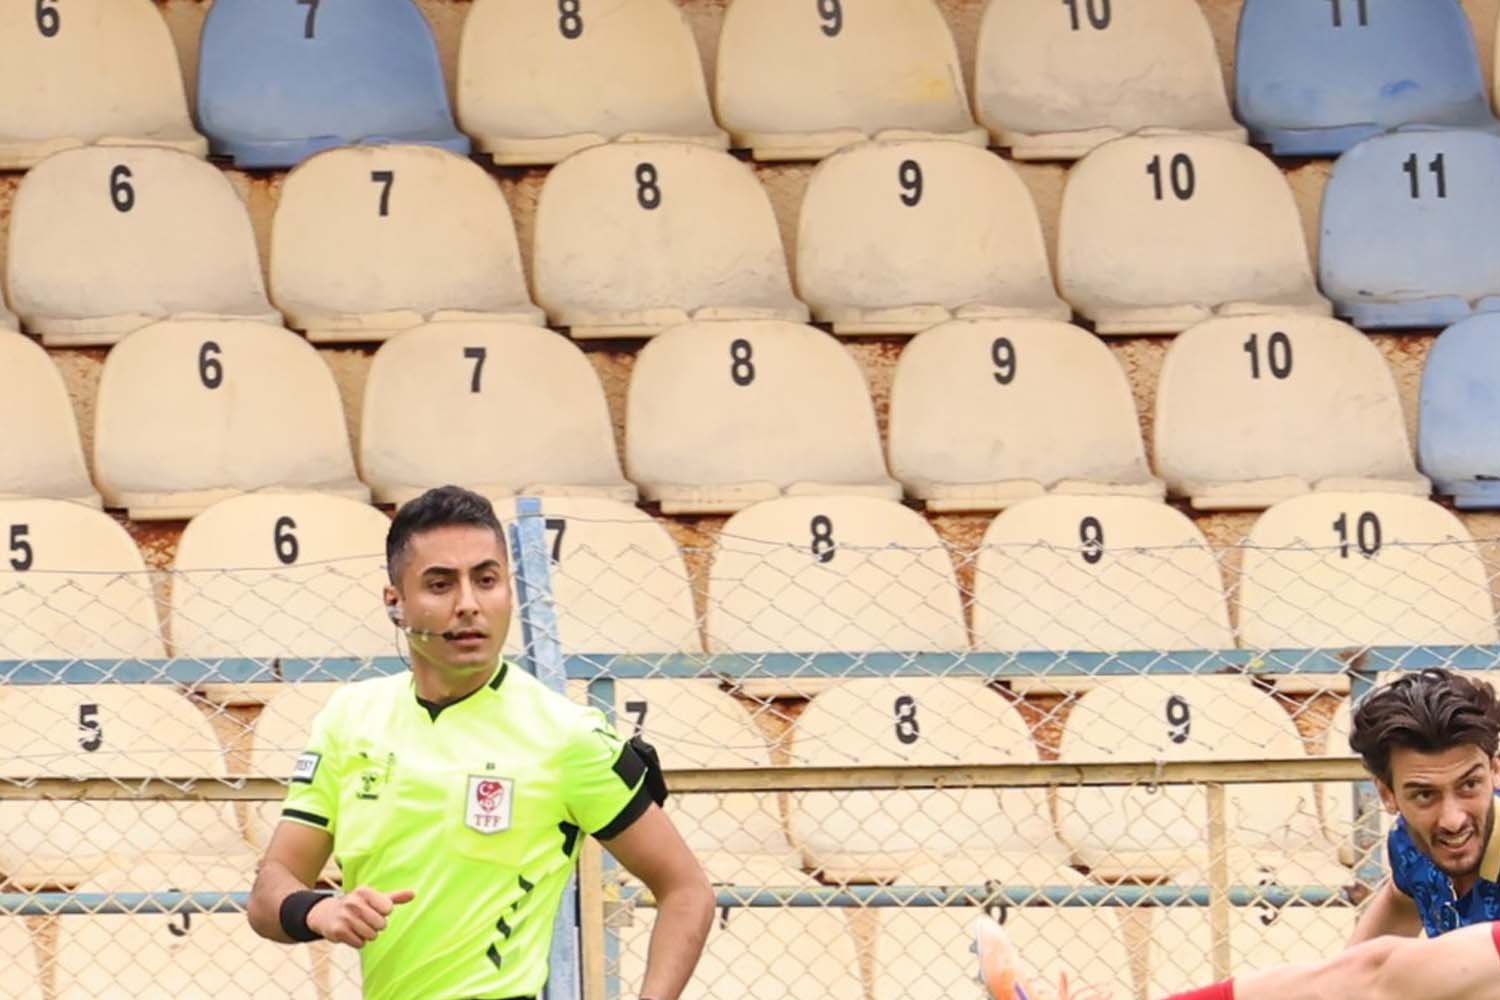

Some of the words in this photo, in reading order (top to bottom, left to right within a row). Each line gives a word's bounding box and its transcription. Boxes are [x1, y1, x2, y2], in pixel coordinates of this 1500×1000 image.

[36, 0, 59, 37] 6
[296, 0, 320, 39] 7
[559, 0, 583, 39] 8
[818, 0, 842, 37] 9
[110, 165, 134, 212] 6
[371, 171, 394, 216] 7
[636, 163, 660, 209] 8
[899, 160, 922, 206] 9
[1146, 154, 1195, 200] 10
[1402, 153, 1447, 198] 11
[199, 342, 222, 389] 6
[464, 348, 486, 393] 7
[730, 339, 755, 385] 8
[992, 338, 1016, 384] 9
[1244, 332, 1292, 379] 10
[10, 525, 33, 571] 5
[275, 517, 298, 564] 6
[811, 516, 834, 562] 8
[1080, 517, 1104, 564] 9
[1333, 512, 1380, 558] 10
[79, 704, 102, 752] 5
[625, 702, 648, 744] 7
[895, 697, 918, 744] 8
[1167, 696, 1190, 744] 9
